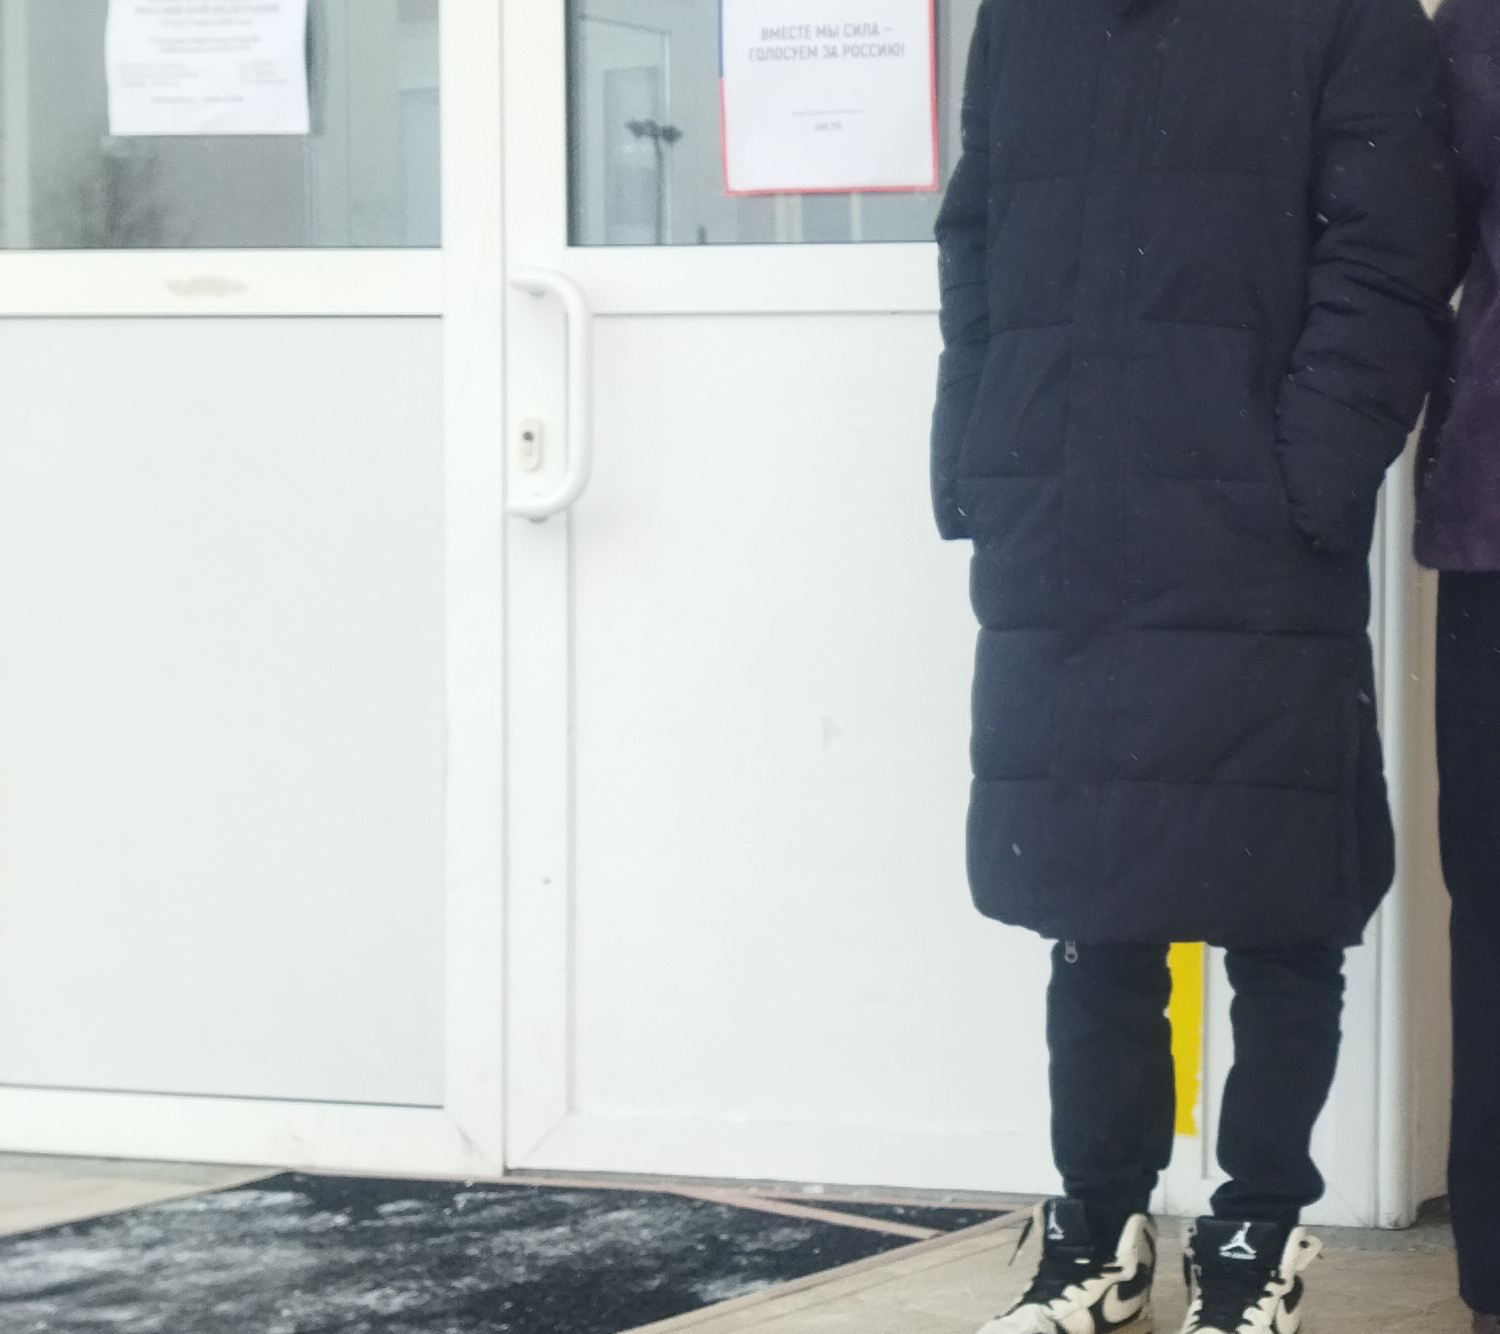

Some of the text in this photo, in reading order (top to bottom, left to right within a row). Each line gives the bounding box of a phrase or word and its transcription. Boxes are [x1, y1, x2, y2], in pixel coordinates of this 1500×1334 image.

[760, 24, 811, 41] ВМЕСТЕ
[815, 23, 840, 38] МЫ
[843, 22, 881, 37] СИЛА
[748, 42, 905, 61] ГОЛОСУЕМ ЗА РОССИЮ!
